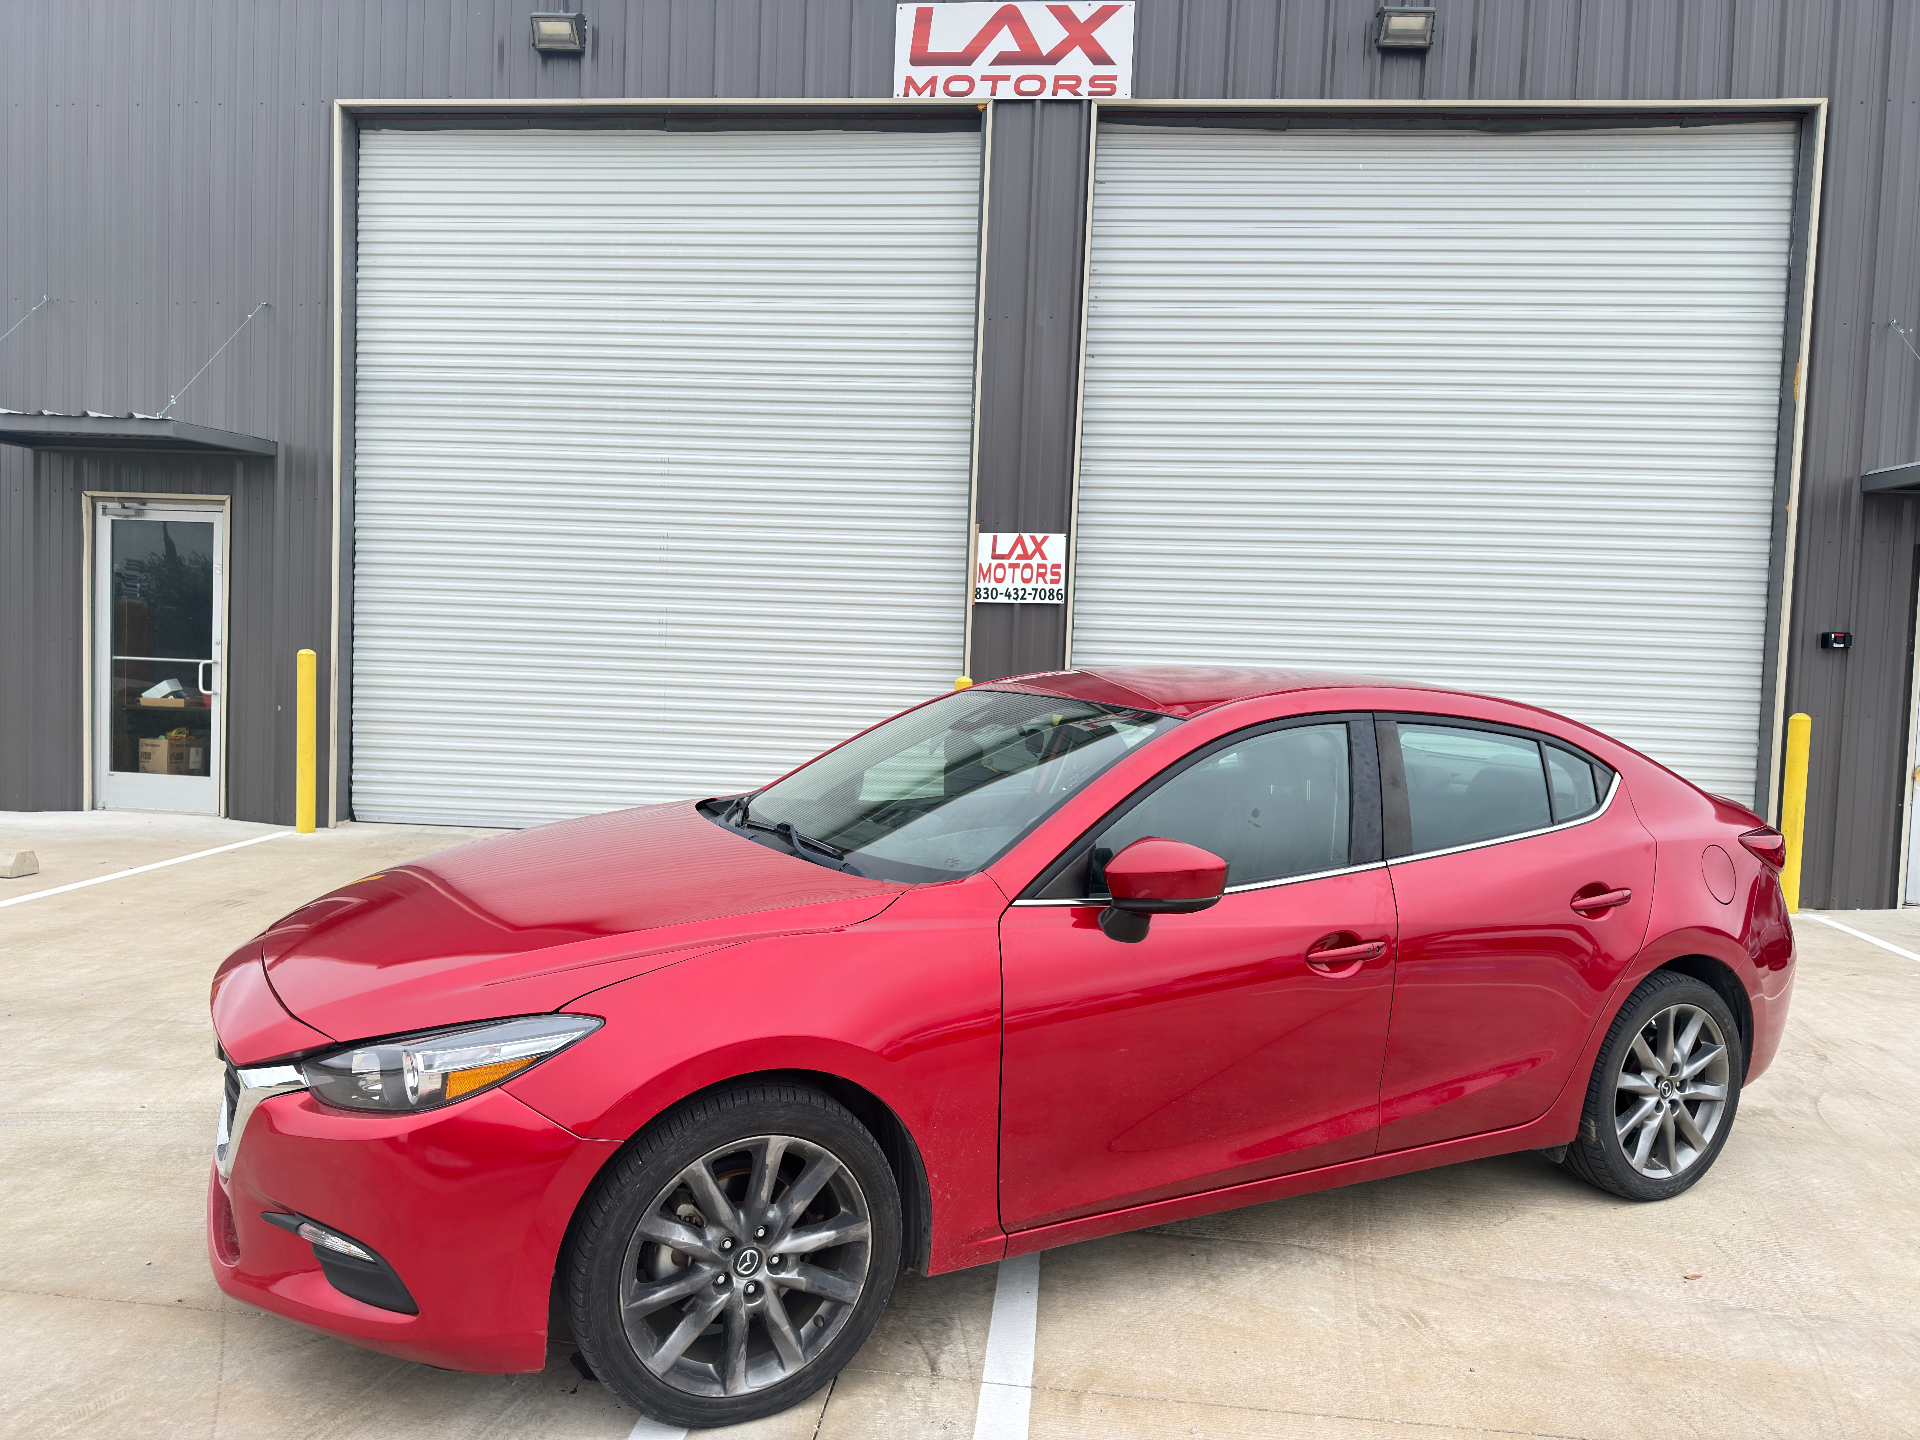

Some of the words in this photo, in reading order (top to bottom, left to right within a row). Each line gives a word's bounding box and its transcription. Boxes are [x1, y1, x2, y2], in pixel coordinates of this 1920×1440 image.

[909, 4, 1124, 66] LAX
[903, 74, 1118, 97] MOTORS
[991, 535, 1050, 560] LAX
[978, 563, 1062, 584] MOTORS
[975, 587, 1064, 601] 830-432-7086
